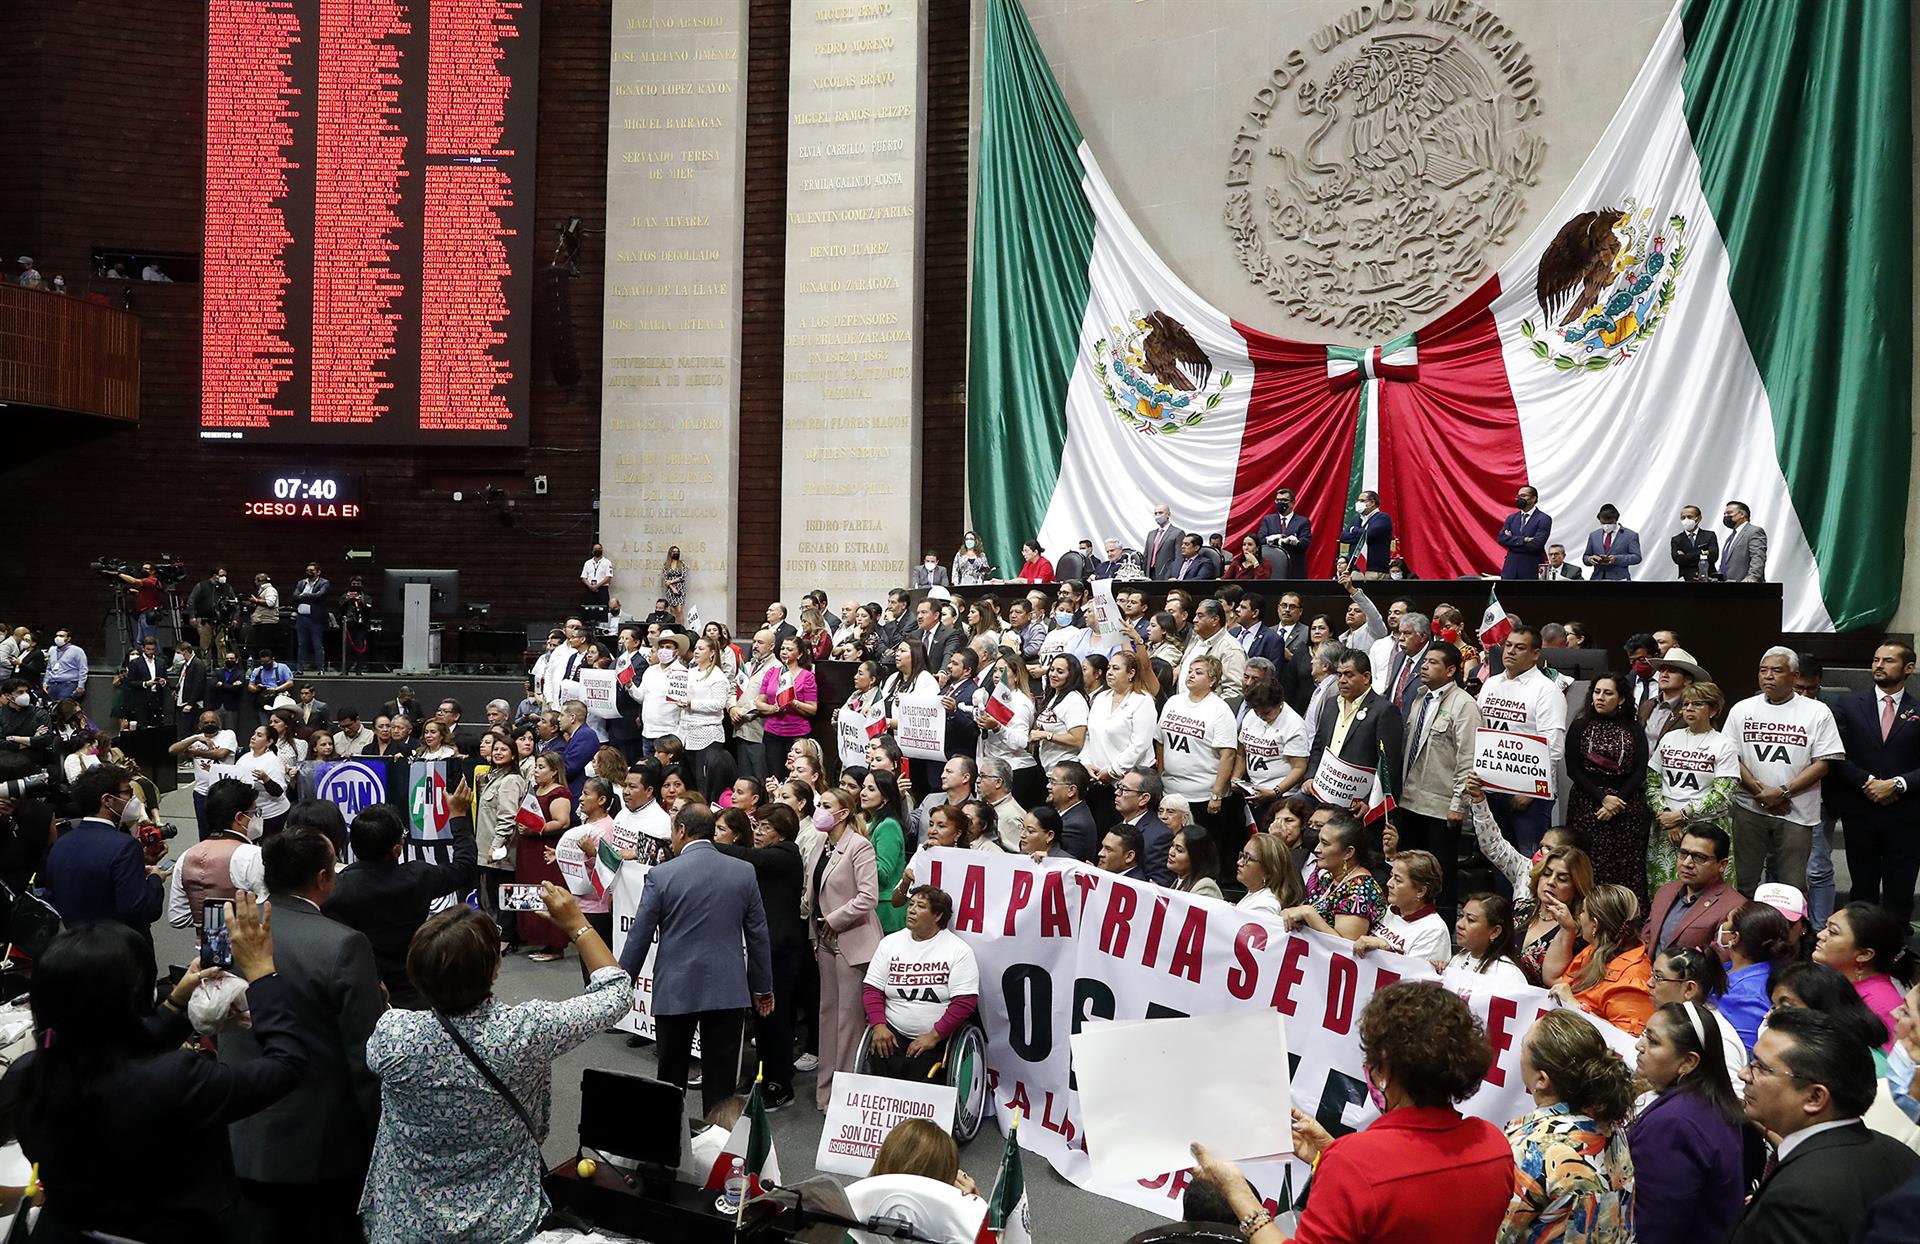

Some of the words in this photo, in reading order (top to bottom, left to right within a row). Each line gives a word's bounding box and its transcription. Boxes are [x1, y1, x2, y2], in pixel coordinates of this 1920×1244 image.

[815, 8, 853, 21] MIGUEL
[627, 18, 674, 30] MARIANO
[815, 42, 848, 55] PEDRO
[852, 37, 895, 52] MORENO
[641, 50, 688, 62] MARIANO
[693, 48, 738, 61] JIMENEZ
[616, 84, 657, 96] IGNACIO
[662, 83, 693, 96] LOPEZ
[697, 82, 732, 95] RAYON
[812, 76, 856, 90] NICOLAS
[860, 72, 896, 87] BRAVO
[1225, 49, 1307, 187] ESTADOS
[1309, 0, 1416, 53] UNIDOS
[1426, 0, 1544, 120] MEXICANOS
[793, 111, 830, 125] MIGUEL
[835, 108, 871, 123] RAMOS
[875, 104, 912, 119] ARIZPE
[623, 118, 662, 130] MIGUEL
[666, 117, 722, 129] BARRAGAN
[622, 151, 674, 163] SERVANDO
[681, 150, 721, 162] TERESA
[799, 145, 822, 158] ELVIA
[826, 142, 865, 156] CARRILLO
[649, 168, 662, 180] DE
[669, 168, 694, 179] MIER
[836, 174, 872, 189] GALINDO
[874, 172, 903, 186] ACOSTA
[631, 217, 657, 228] JUAN
[664, 215, 711, 227] ALVAREZ
[789, 210, 838, 225] VALENTIN
[841, 207, 876, 221] GOMEZ
[877, 205, 914, 219] FARIAS
[617, 250, 656, 262] SANTOS
[661, 249, 720, 261] DEGOLLADO
[809, 245, 847, 258] BENITO
[851, 241, 891, 256] JUAREZ
[658, 284, 671, 296] DE
[675, 284, 688, 296] LA
[800, 280, 841, 294] IGNACIO
[846, 276, 900, 292] ZARAGOZA
[811, 316, 829, 329] LOS
[834, 311, 898, 327] DEFENSORES
[785, 335, 799, 347] DE
[801, 333, 841, 346] PUEBLA
[843, 331, 856, 345] DE
[858, 329, 912, 344] ZARAGOZA
[274, 478, 337, 500] 07:40
[302, 504, 312, 516] A
[318, 504, 337, 516] LA
[805, 520, 839, 532] ISIDRO
[843, 519, 883, 532] FABELA
[798, 542, 839, 554] GENARO
[845, 541, 890, 554] ESTRADA
[785, 560, 817, 572] JUSTO
[821, 559, 858, 572] SIERRA
[862, 559, 905, 572] MENDEZ
[1485, 697, 1526, 711] REFORMA
[1166, 713, 1206, 729] REFORMA
[1487, 718, 1510, 732] VA
[1744, 721, 1807, 735] REFORMA
[1166, 732, 1190, 754] VA
[1498, 740, 1524, 750] ALTO
[1744, 732, 1806, 746] ELÉCTRICA
[1482, 748, 1494, 758] AL
[1496, 750, 1540, 764] SAQUEO
[1661, 749, 1716, 762] REFORMA
[1754, 744, 1792, 765] VA
[1248, 754, 1269, 772] VA
[1476, 759, 1488, 768] DE
[1490, 762, 1502, 771] LA
[1506, 764, 1546, 778] NACIÓN
[1326, 764, 1368, 784] SOBERANÍA
[1666, 770, 1700, 790] VA
[413, 776, 444, 815] PRI
[1318, 781, 1354, 800] DEFIENDE
[1536, 784, 1546, 794] PT
[332, 780, 372, 815] PAN
[930, 860, 985, 934] LA
[1226, 922, 1309, 1017] SE
[889, 962, 950, 972] REFORMA
[888, 973, 949, 985] ELÉCTRICA
[897, 988, 942, 1004] VA
[632, 998, 646, 1014] LA
[634, 1018, 648, 1033] LA
[846, 1092, 858, 1107] LA
[861, 1094, 935, 1118] ELECTRICIDAD
[862, 1110, 869, 1124] Y
[870, 1112, 882, 1127] EL
[840, 1124, 860, 1140] SON
[864, 1128, 882, 1144] DEL
